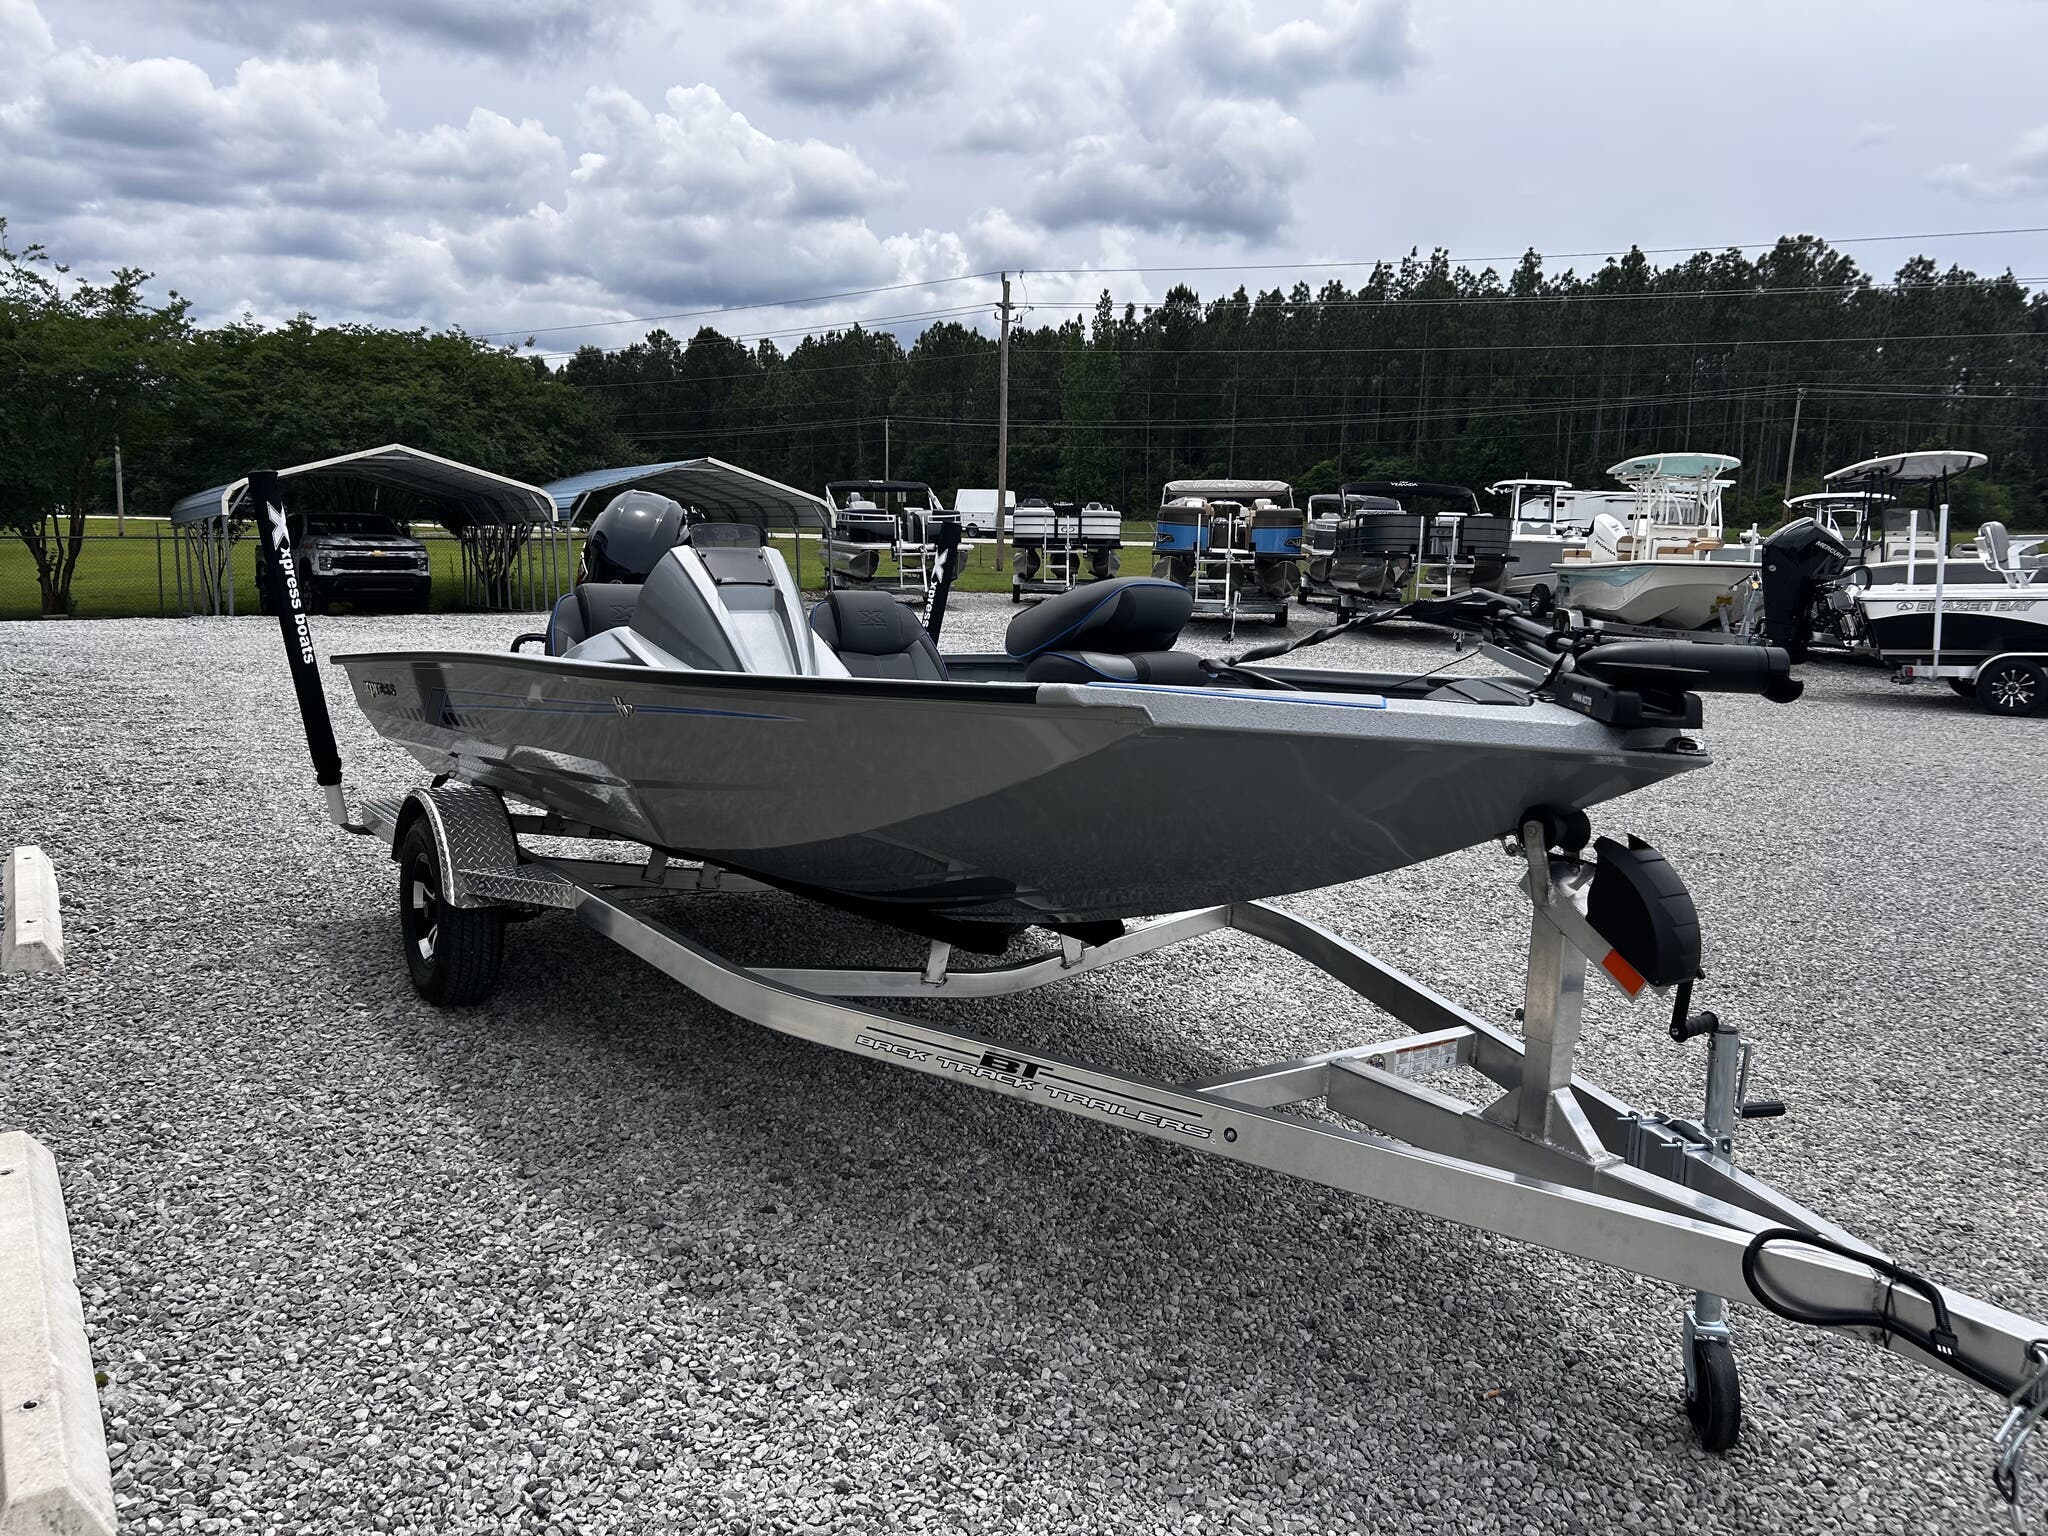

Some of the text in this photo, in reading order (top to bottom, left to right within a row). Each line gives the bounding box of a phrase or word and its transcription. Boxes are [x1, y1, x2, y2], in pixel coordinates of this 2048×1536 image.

[1595, 540, 1616, 557] HONDA
[1815, 540, 1845, 560] MERCURY
[278, 547, 314, 664] xpress boats
[922, 581, 938, 628] xpress
[1916, 600, 2038, 612] BLAZER BAY
[980, 1050, 1054, 1079] BT
[855, 1034, 1212, 1140] BACK TRACK TRAILERS
